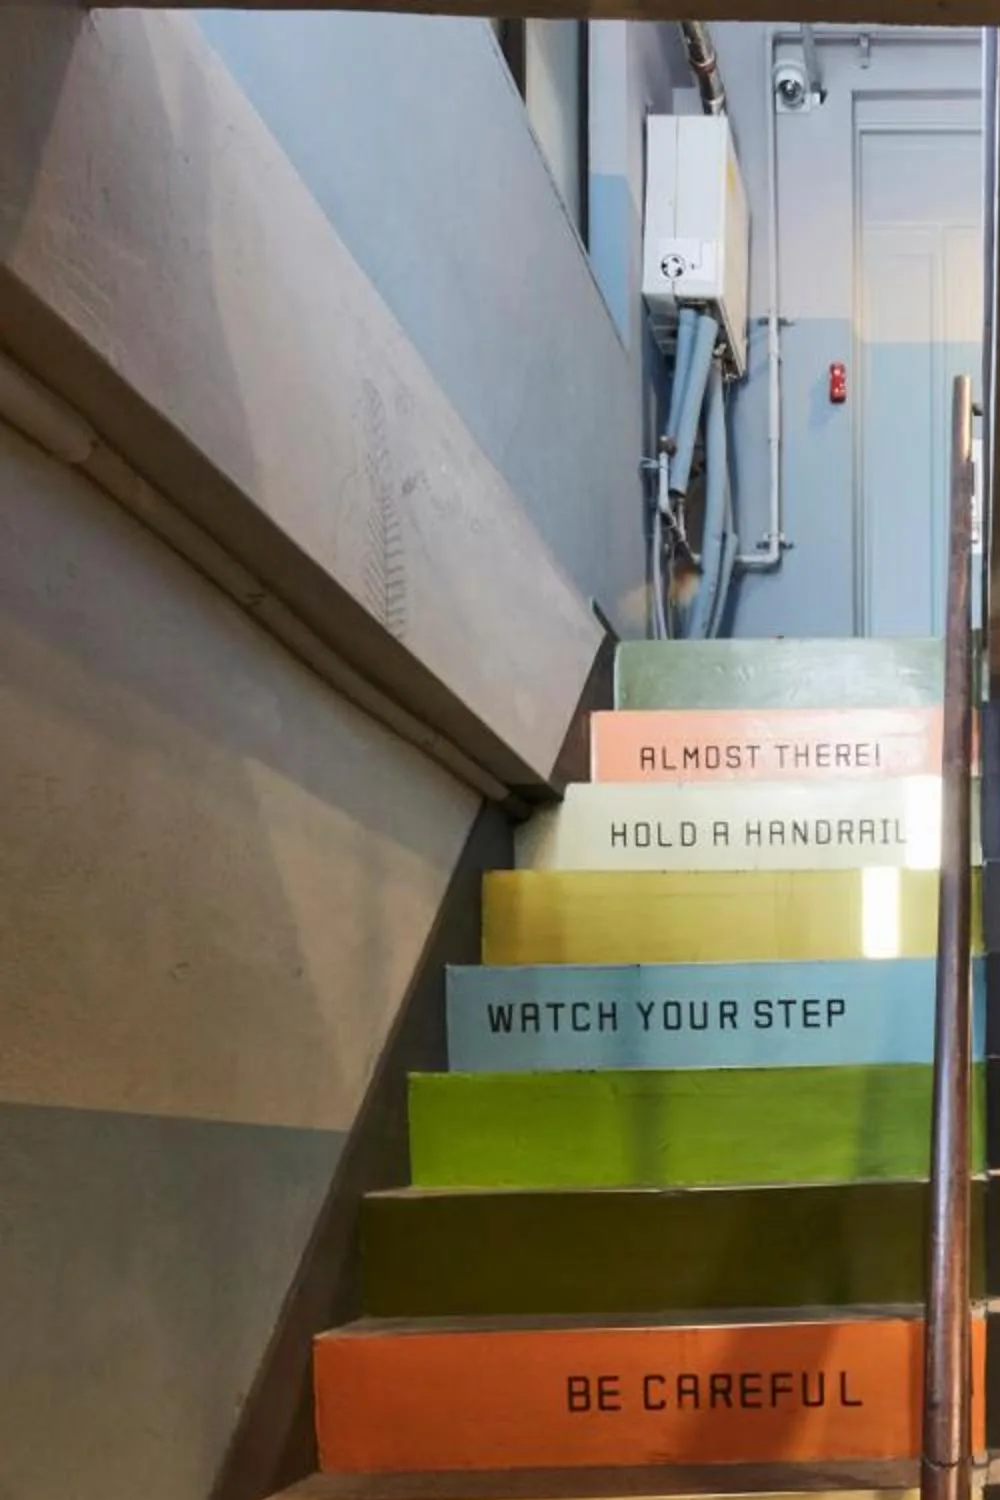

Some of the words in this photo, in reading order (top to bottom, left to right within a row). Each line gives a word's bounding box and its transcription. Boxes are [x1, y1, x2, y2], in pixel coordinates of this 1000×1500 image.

[639, 744, 761, 770] ALMOST
[774, 743, 881, 768] THERE!
[610, 821, 697, 849] HOLD
[712, 821, 730, 846] A
[745, 818, 908, 846] HANDRAIL
[487, 1001, 618, 1034] WATCH
[636, 1000, 739, 1031] YOUR
[753, 998, 847, 1030] STEP
[567, 1375, 622, 1413] BE
[642, 1370, 864, 1411] CAREFUL
